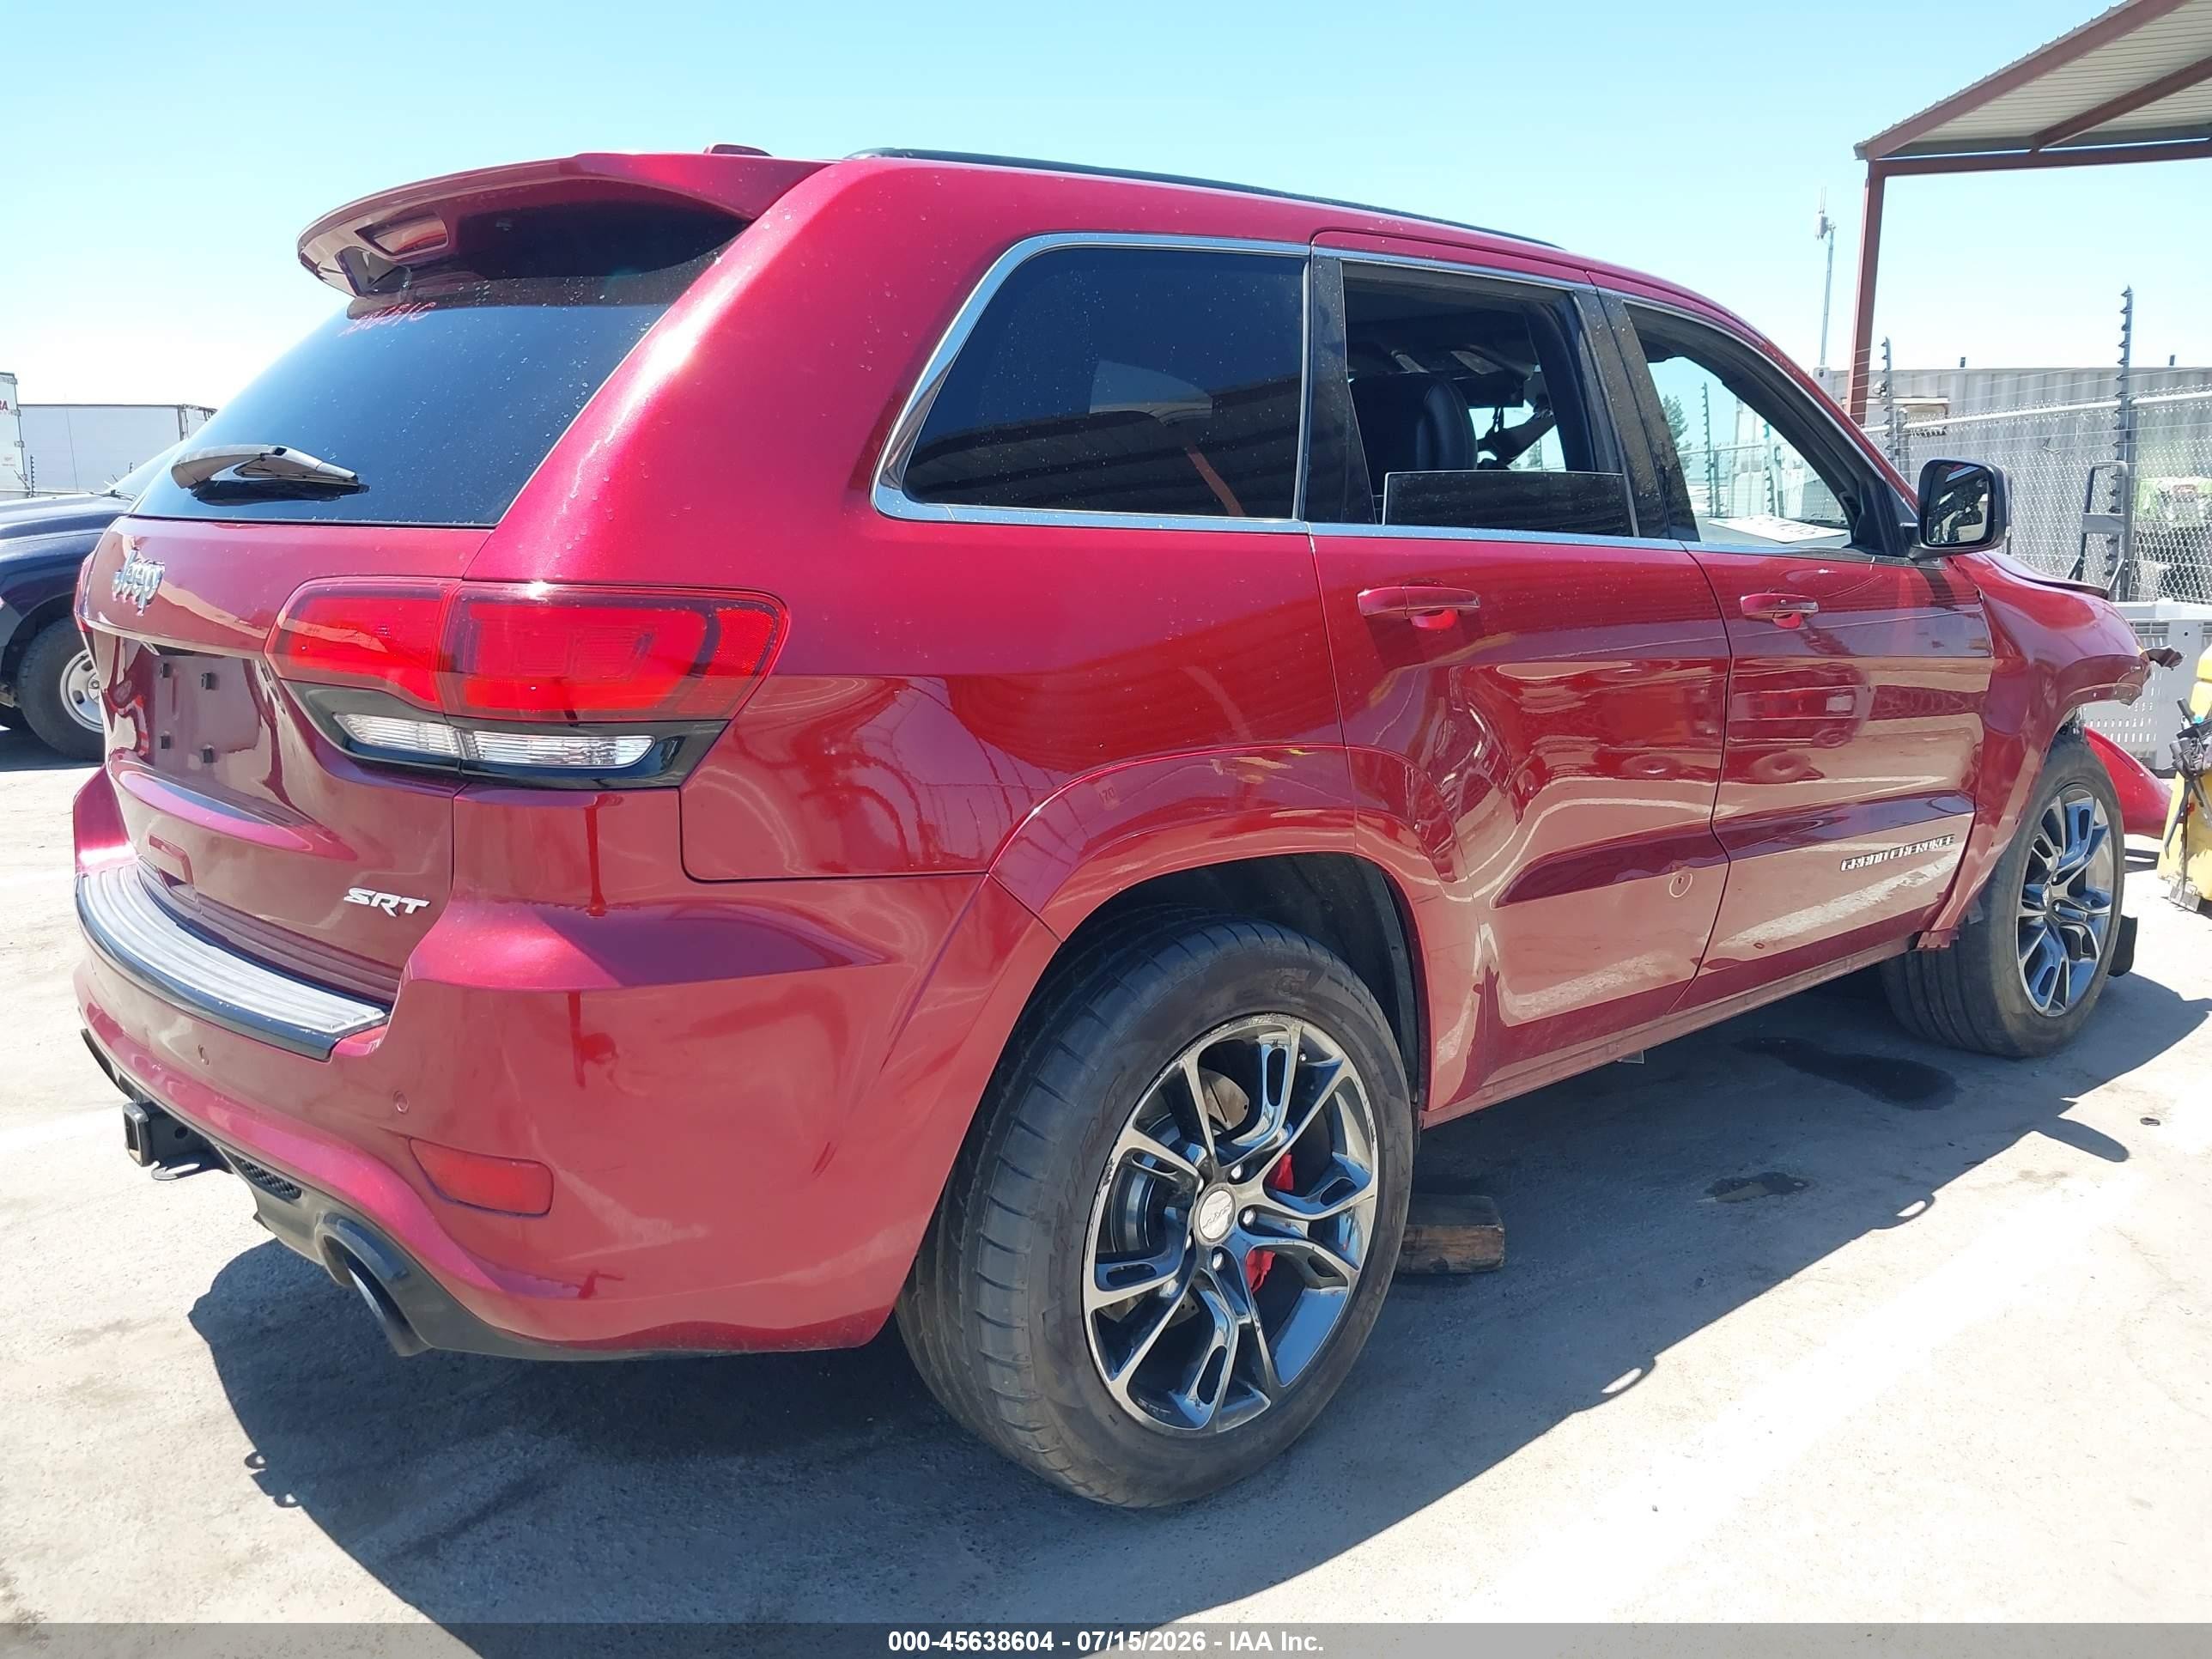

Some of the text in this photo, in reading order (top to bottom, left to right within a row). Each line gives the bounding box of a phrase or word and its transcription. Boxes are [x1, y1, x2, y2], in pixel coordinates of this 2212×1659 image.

[112, 550, 165, 607] Jeep
[1840, 833, 1955, 872] GRAND CHEROKEE
[343, 887, 431, 918] SRT
